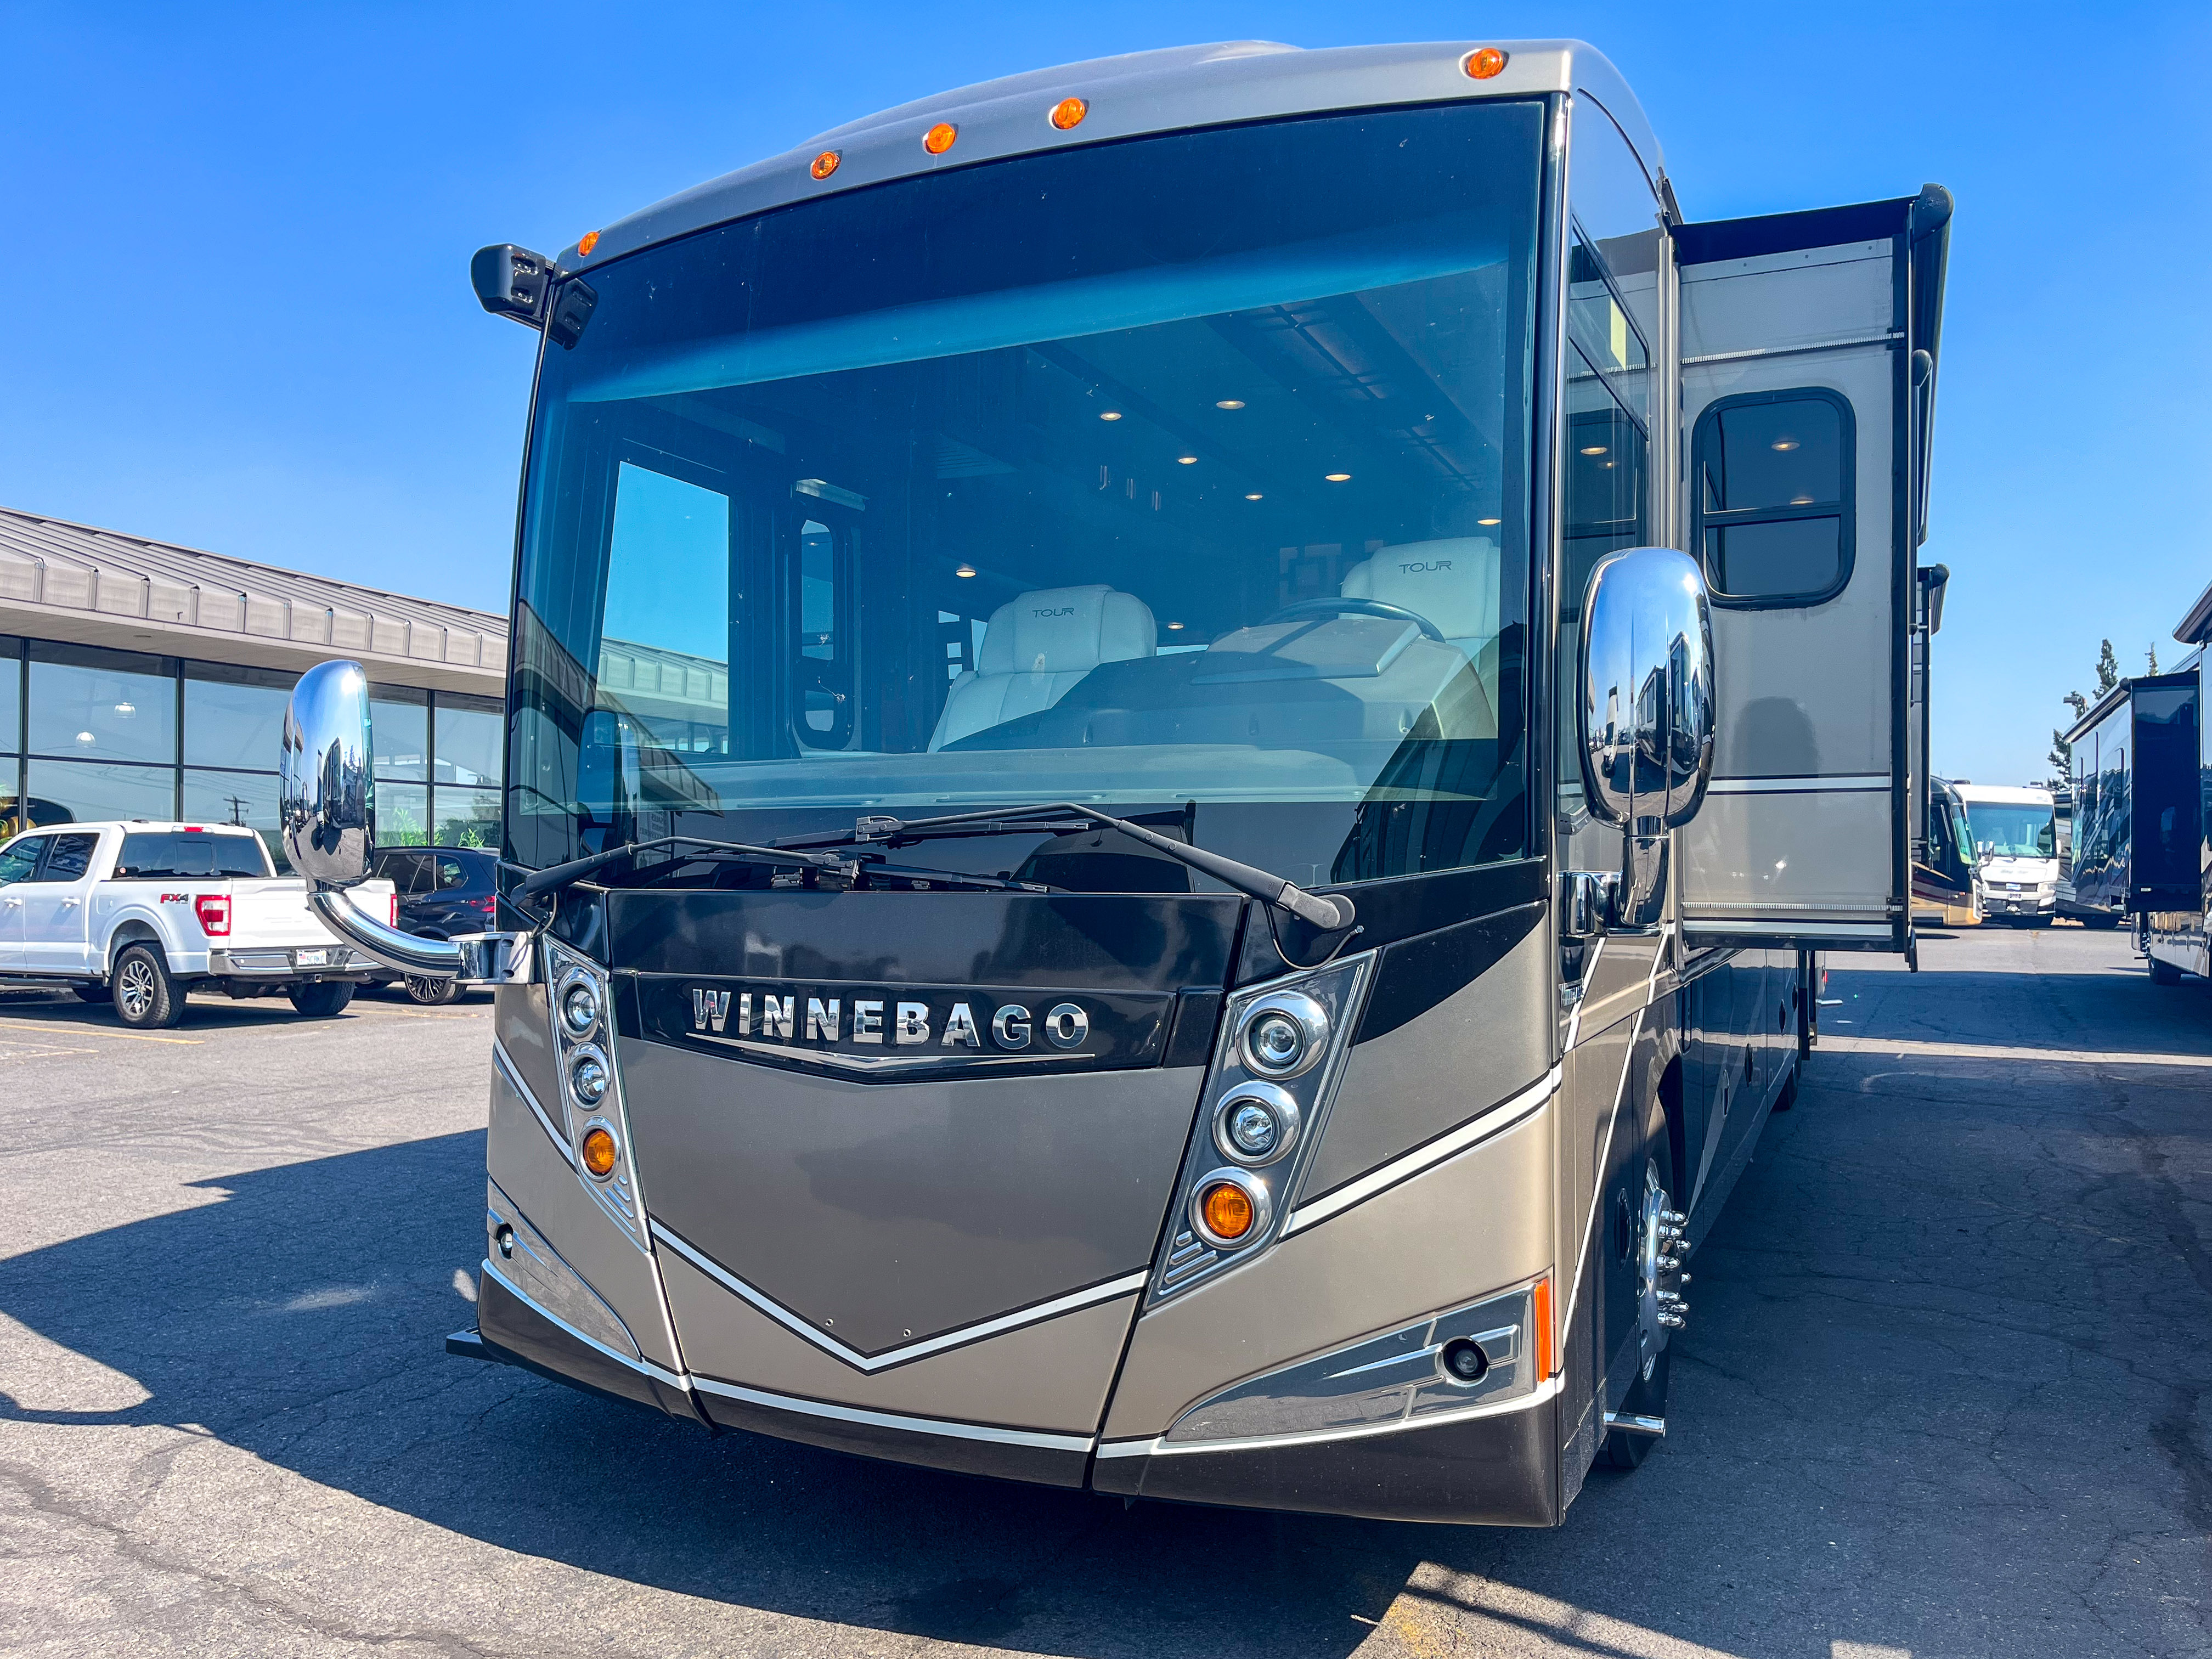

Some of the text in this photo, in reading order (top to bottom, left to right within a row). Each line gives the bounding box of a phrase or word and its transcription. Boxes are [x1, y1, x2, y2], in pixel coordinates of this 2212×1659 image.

[1398, 561, 1452, 574] TOUR
[1032, 607, 1074, 618] TOUR
[160, 894, 189, 904] FX4
[692, 988, 1089, 1049] WINNEBAGO
